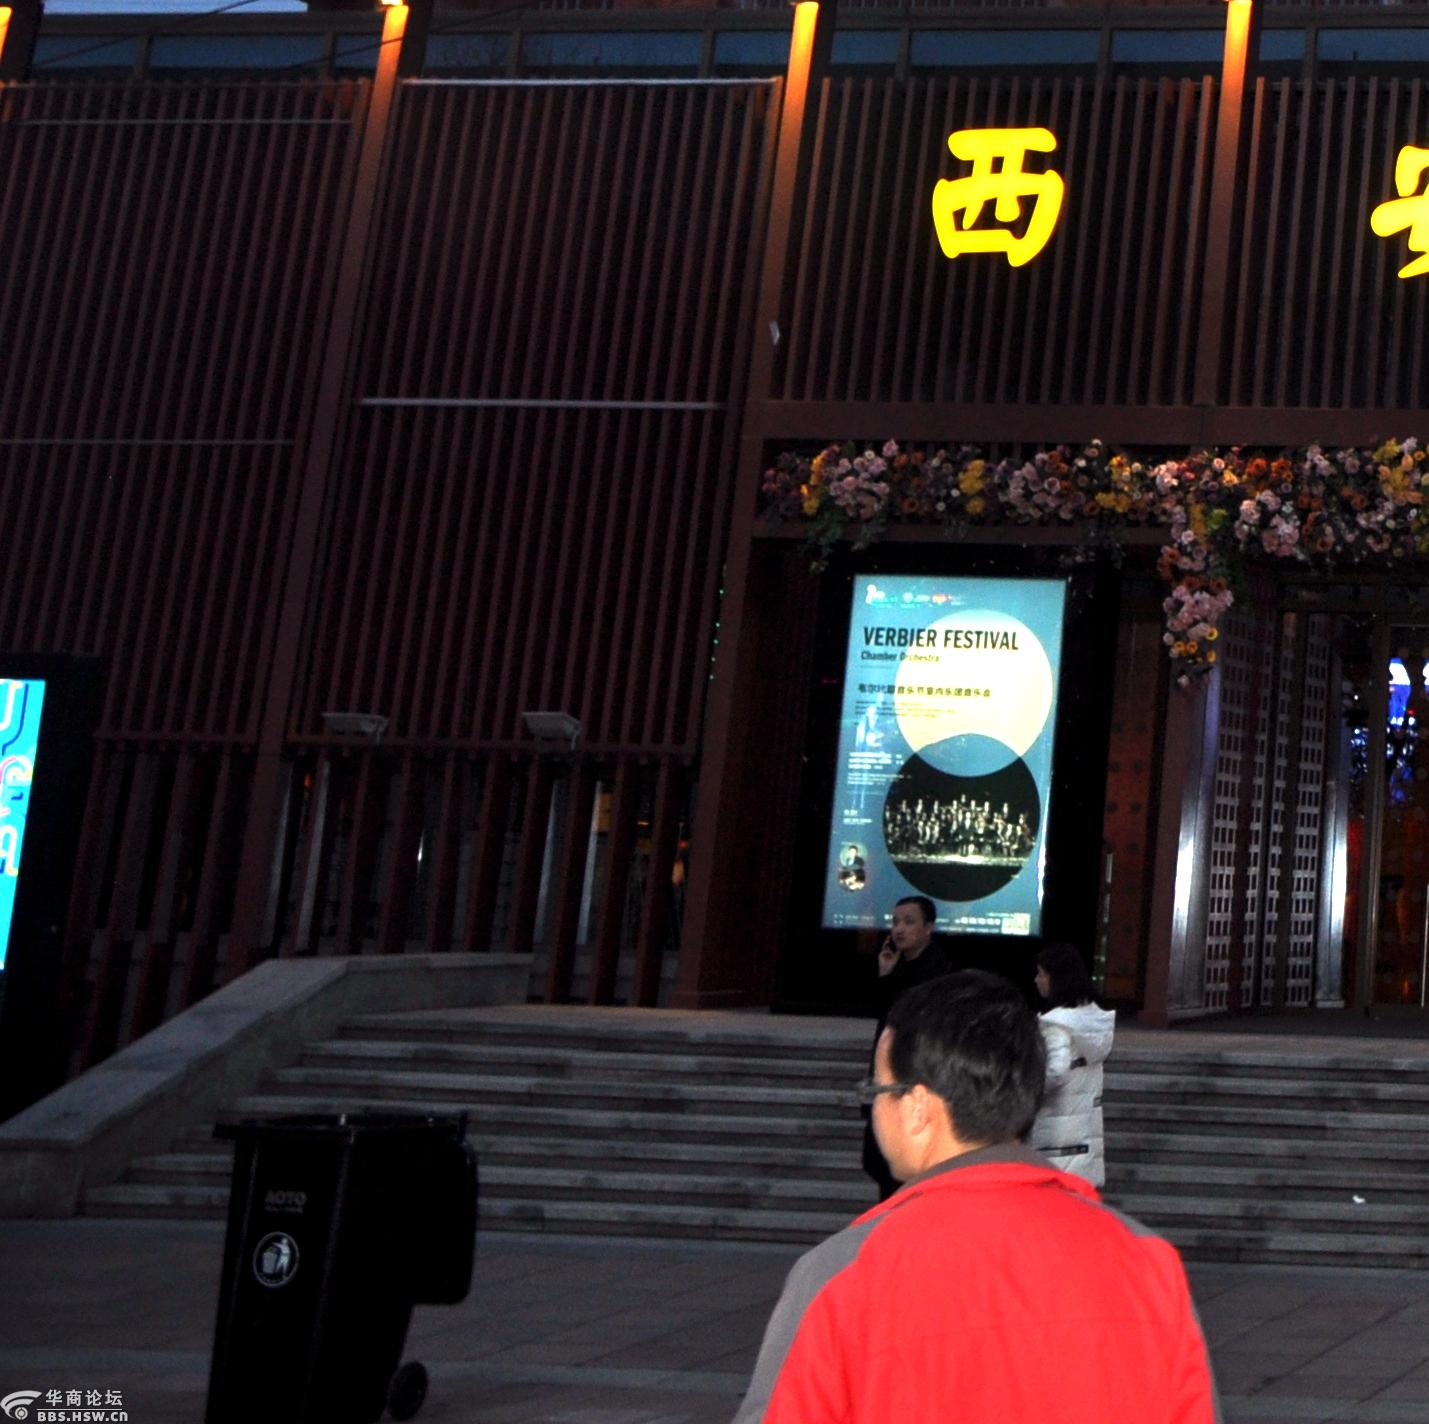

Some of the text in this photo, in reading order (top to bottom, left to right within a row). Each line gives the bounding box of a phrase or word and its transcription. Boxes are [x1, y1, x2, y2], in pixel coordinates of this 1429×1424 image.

[863, 626, 1019, 651] VERBIER FESTIVAL
[860, 650, 897, 662] Chamber
